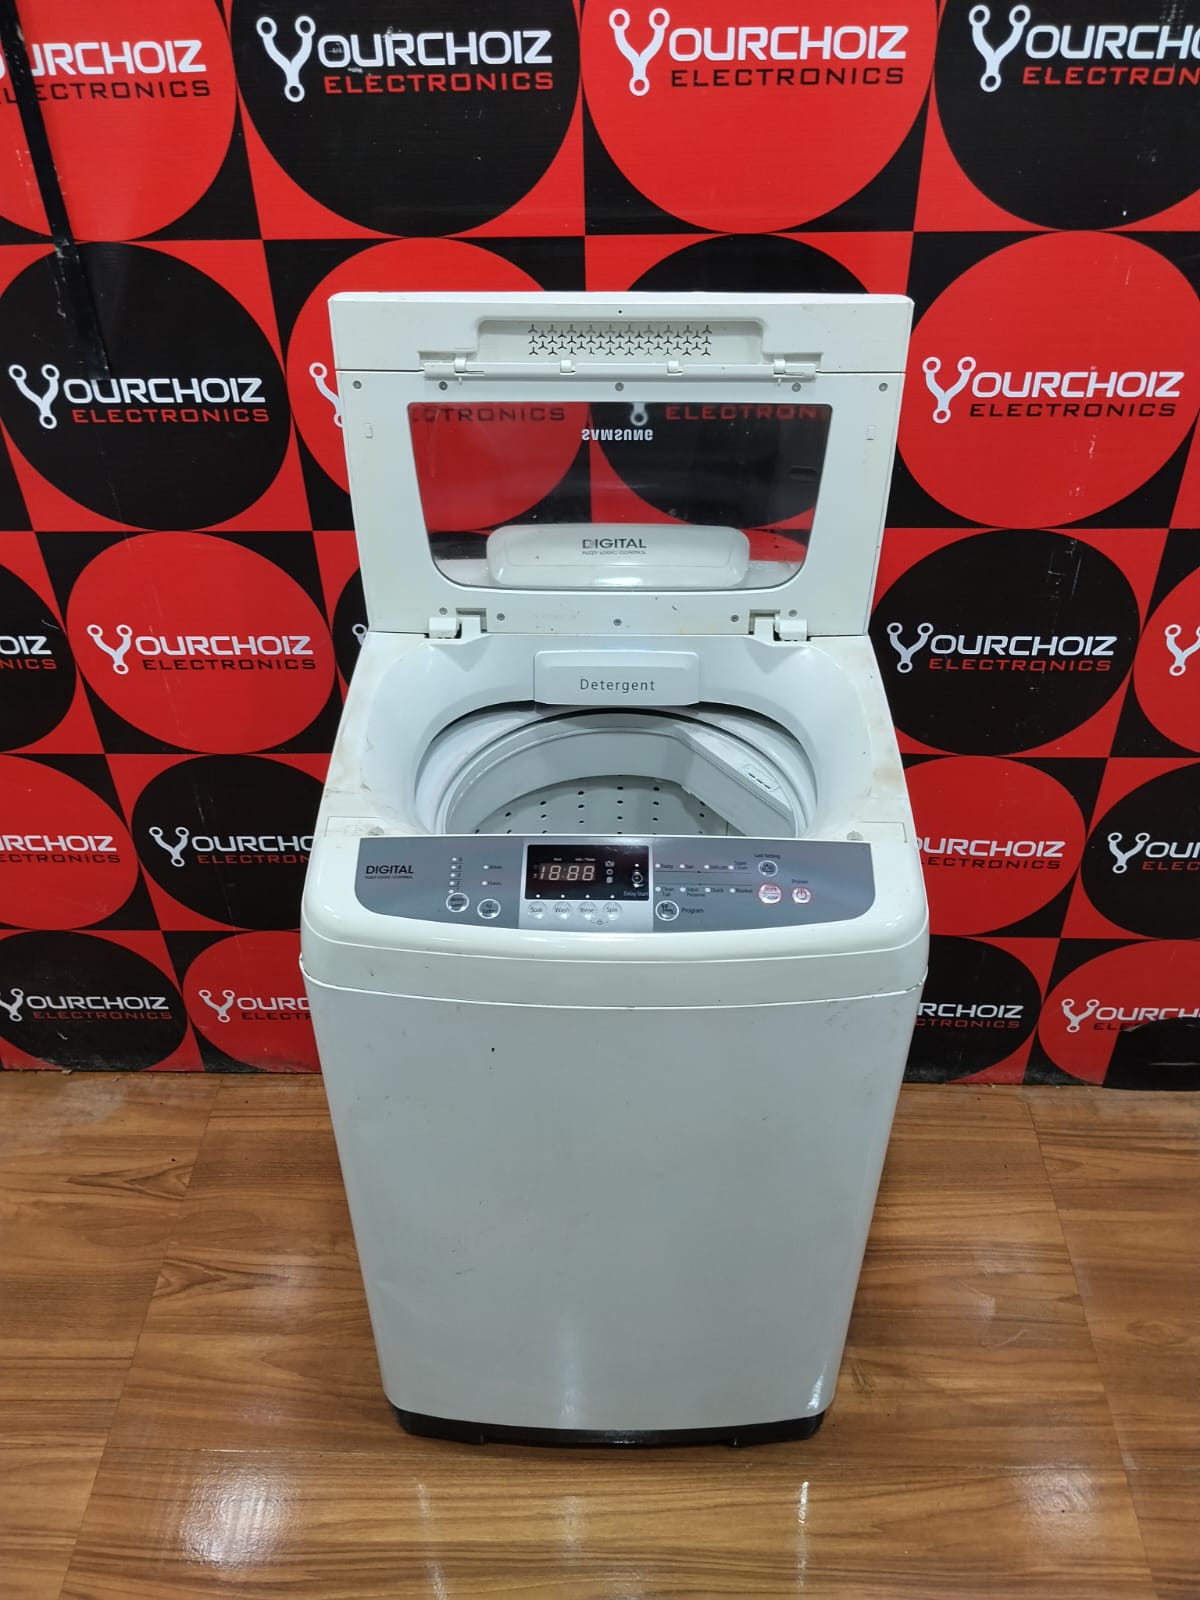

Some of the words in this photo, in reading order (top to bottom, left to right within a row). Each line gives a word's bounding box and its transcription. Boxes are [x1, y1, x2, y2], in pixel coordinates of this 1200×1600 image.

[256, 16, 552, 102] YOURCHOIZ
[609, 8, 908, 96] YOURCHOIZ
[969, 5, 1200, 92] YOURCH
[324, 72, 554, 95] ELECTRONICS
[671, 67, 904, 88] ELECTRONICS
[9, 364, 265, 429] YOURCHOIZ
[922, 357, 1184, 423] YOURCHOIZ
[71, 409, 270, 424] ELECTRONICS
[969, 403, 1176, 418] ELECTRONICS
[582, 538, 648, 549] DIGITAL
[87, 624, 314, 675] YOURCHOIZ
[887, 622, 1117, 673] YOURCHOIZ
[142, 658, 316, 671] ELECTRONICS
[928, 659, 1111, 671] ELECTRONICS
[580, 678, 656, 694] Detergent
[917, 837, 1066, 858] URCHOIZ
[366, 865, 414, 874] DIGITAL
[921, 856, 1060, 870] ECTRONICS
[32, 1010, 173, 1021] ELECTRONICS
[1061, 999, 1200, 1032] YOURCH
